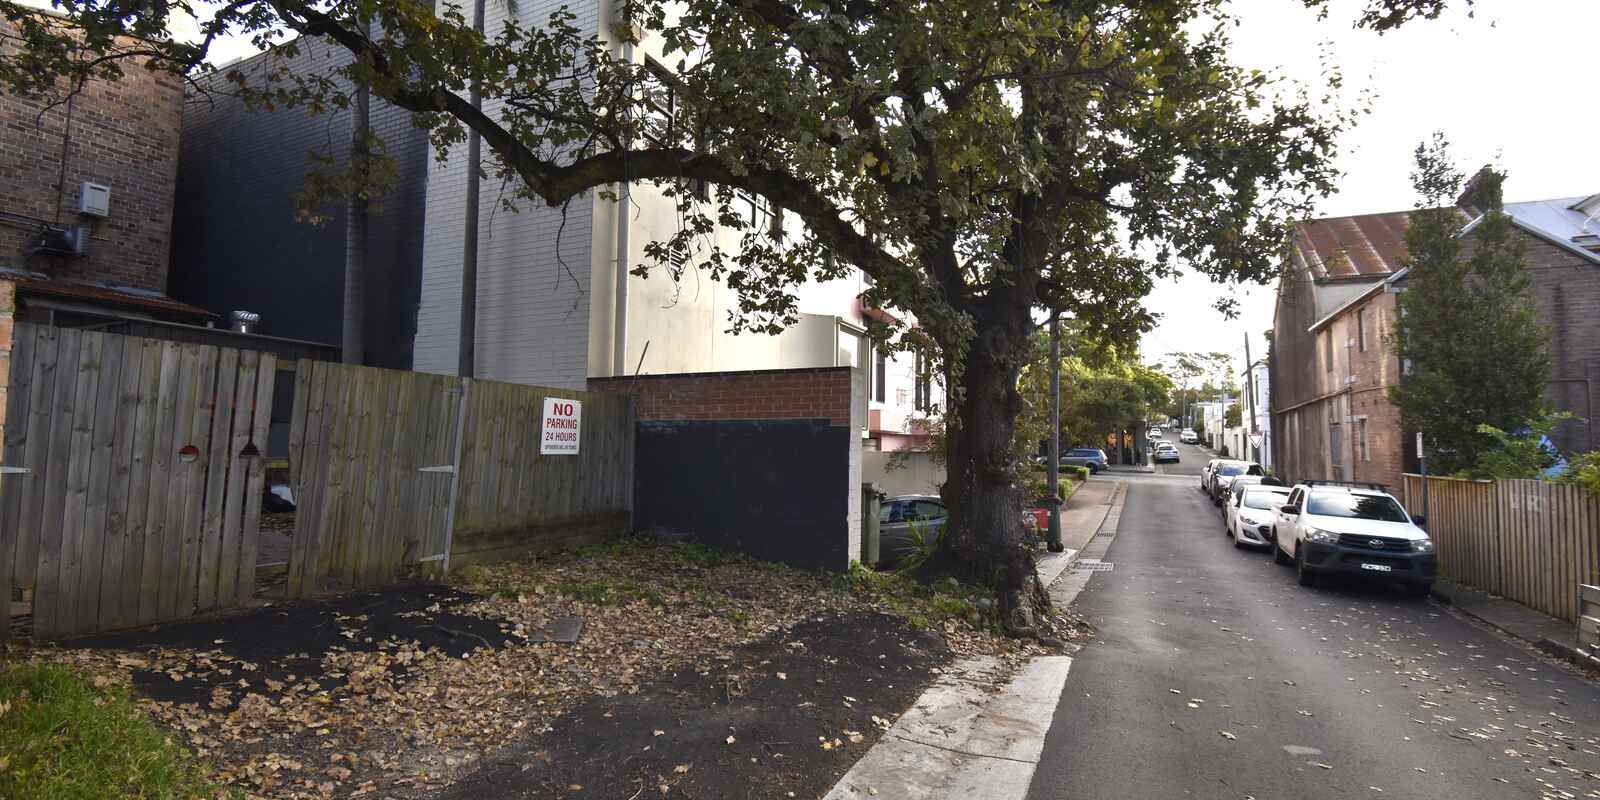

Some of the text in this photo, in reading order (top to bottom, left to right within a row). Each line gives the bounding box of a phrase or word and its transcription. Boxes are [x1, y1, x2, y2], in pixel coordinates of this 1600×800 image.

[553, 403, 573, 416] NO
[546, 418, 577, 429] PARKING
[545, 432, 576, 441] 24 HOURS
